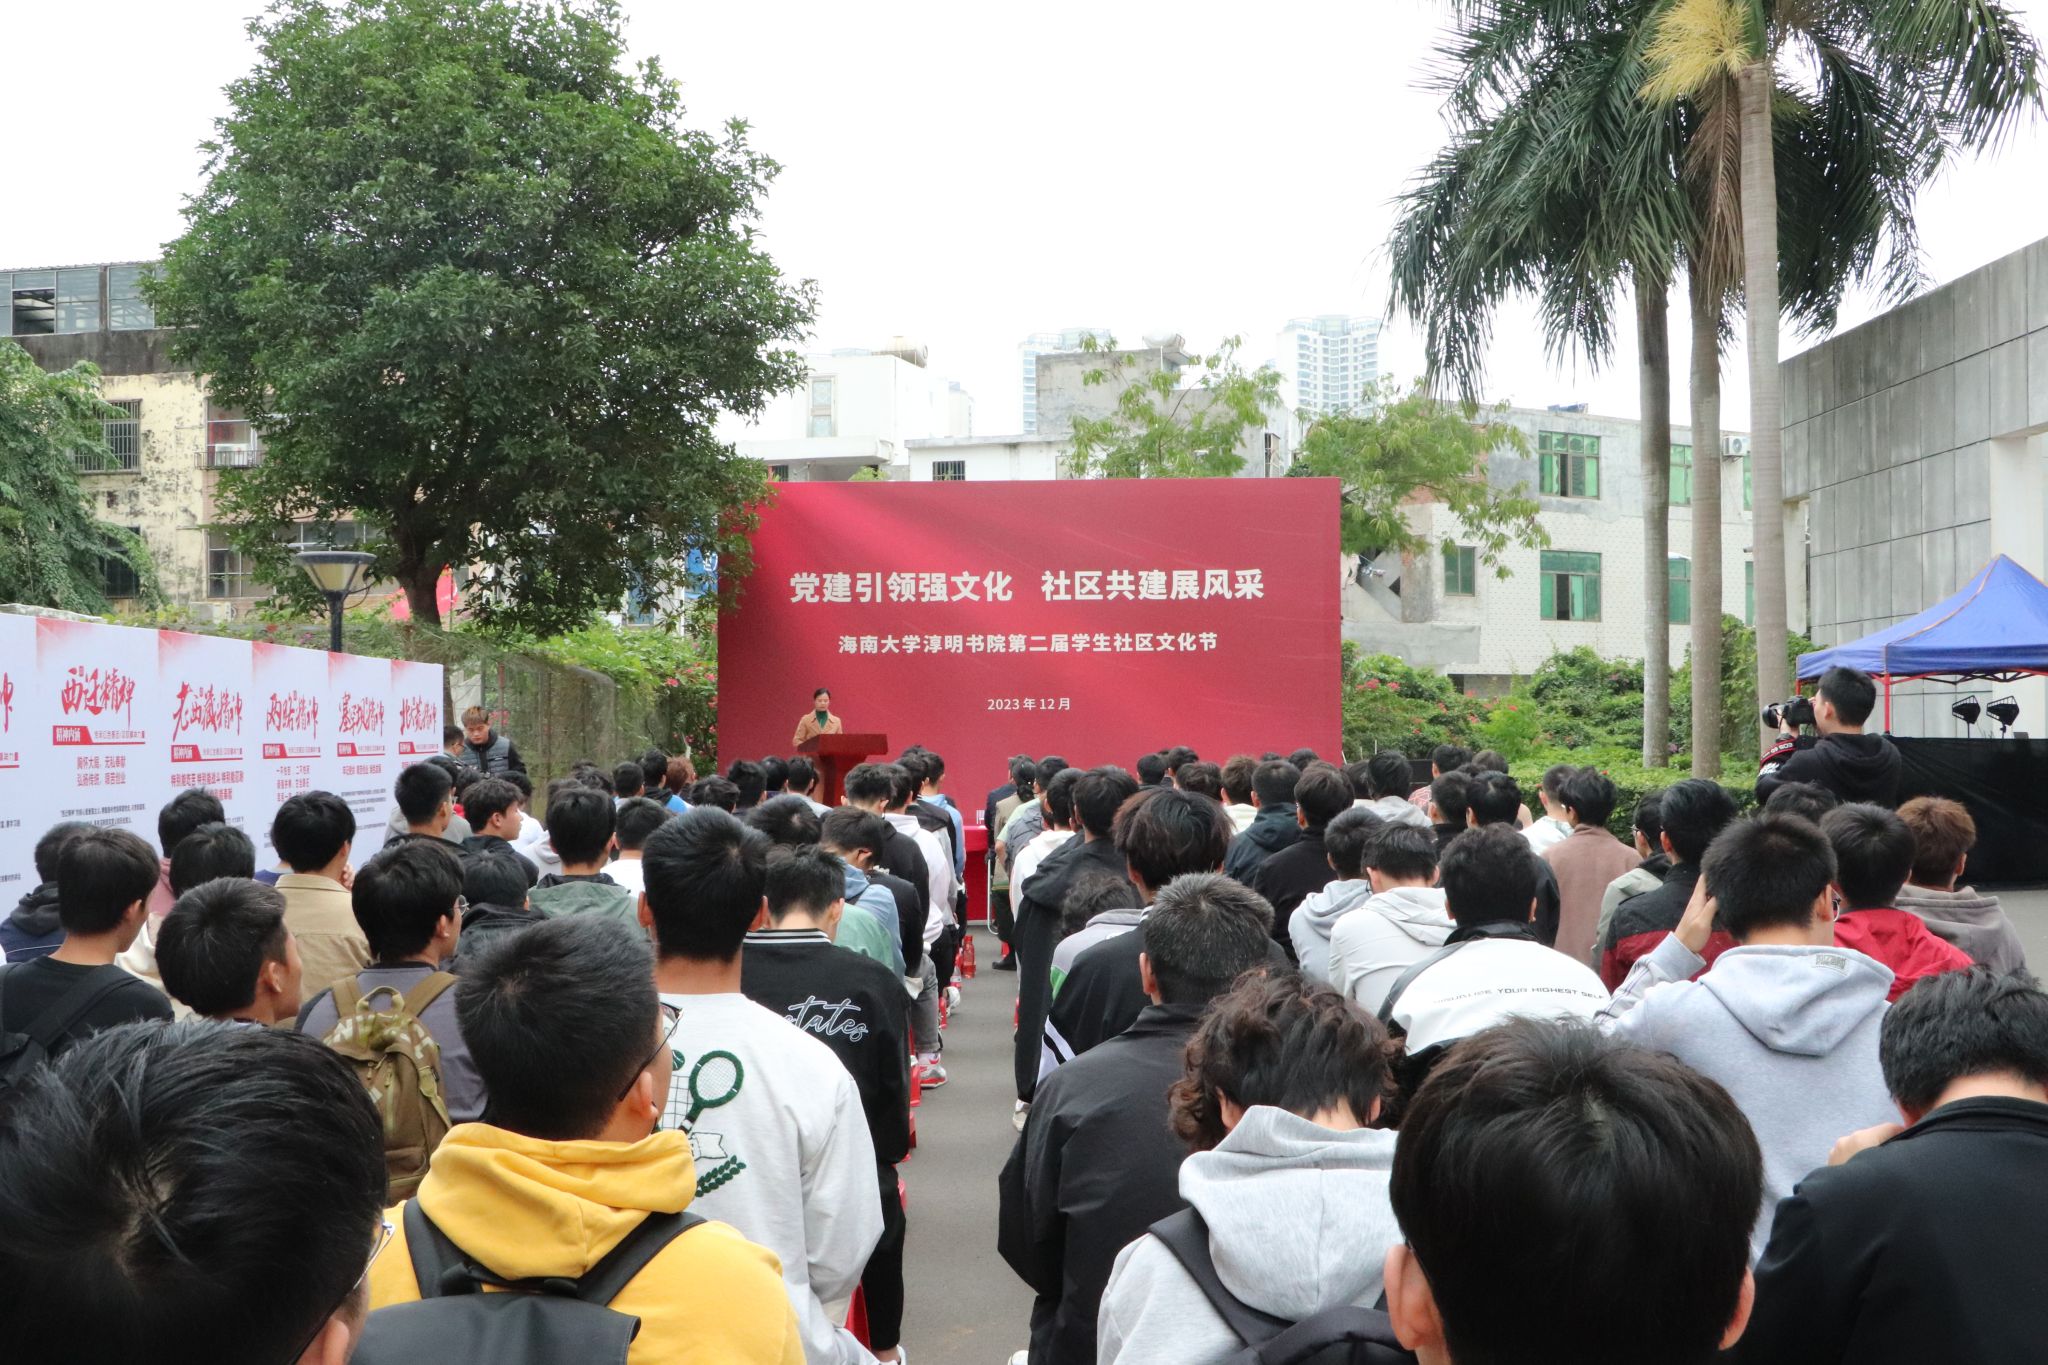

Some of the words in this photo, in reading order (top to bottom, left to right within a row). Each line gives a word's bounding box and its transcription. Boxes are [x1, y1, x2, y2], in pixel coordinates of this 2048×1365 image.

[789, 570, 1013, 603] 党建引领强文化
[1041, 568, 1265, 601] 社区共建展风采
[838, 632, 1218, 654] 海南大学淳明书院第二届学生社区文化节
[1497, 987, 1528, 995] YOUR
[1531, 987, 1578, 996] HIGHEST
